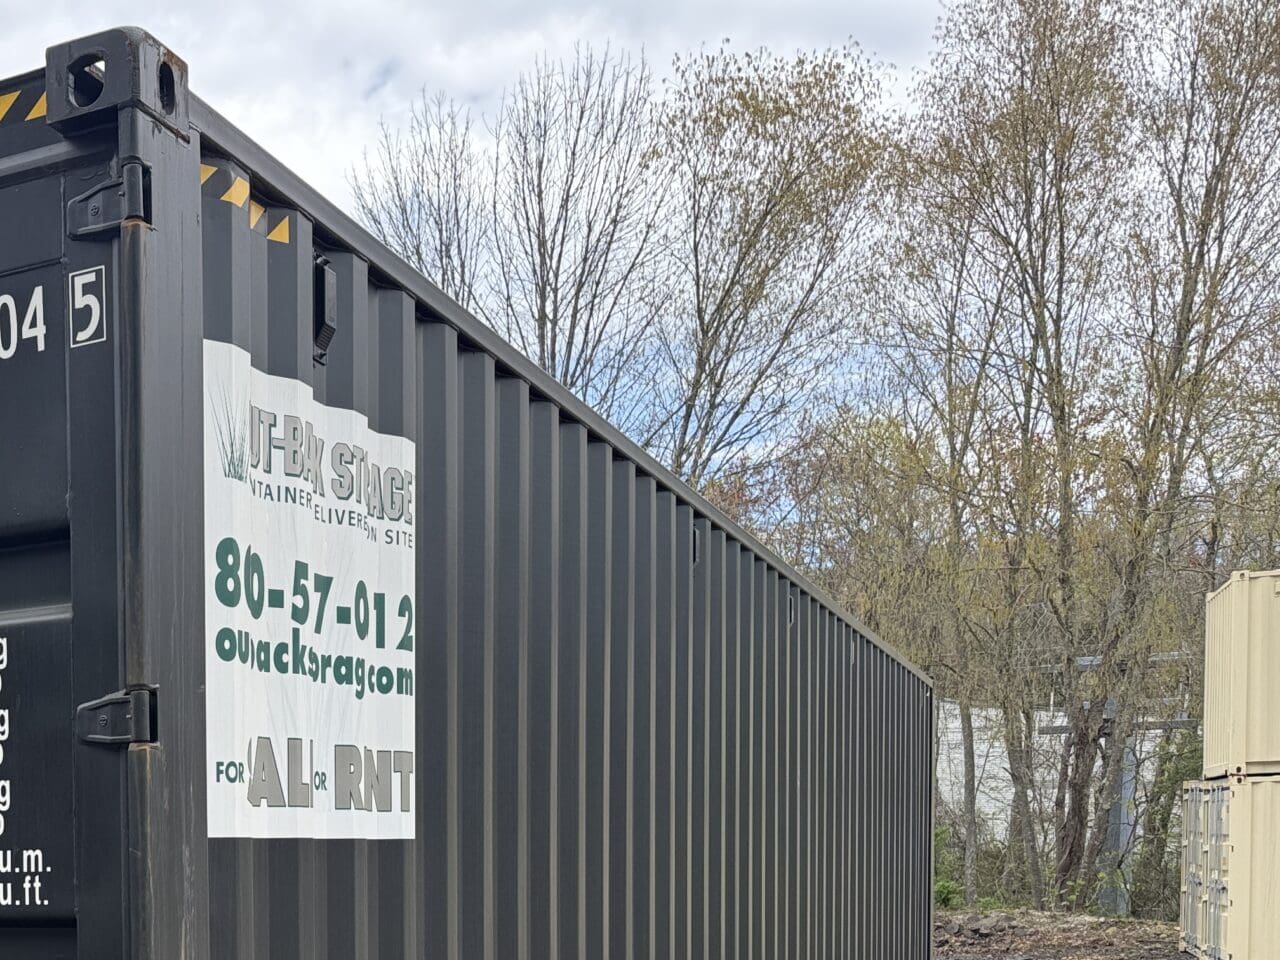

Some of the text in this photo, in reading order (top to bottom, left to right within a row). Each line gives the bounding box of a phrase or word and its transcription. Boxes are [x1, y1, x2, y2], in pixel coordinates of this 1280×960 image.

[73, 271, 102, 342] 5
[384, 528, 413, 549] SITE
[215, 761, 245, 784] FOR
[314, 771, 328, 792] OR
